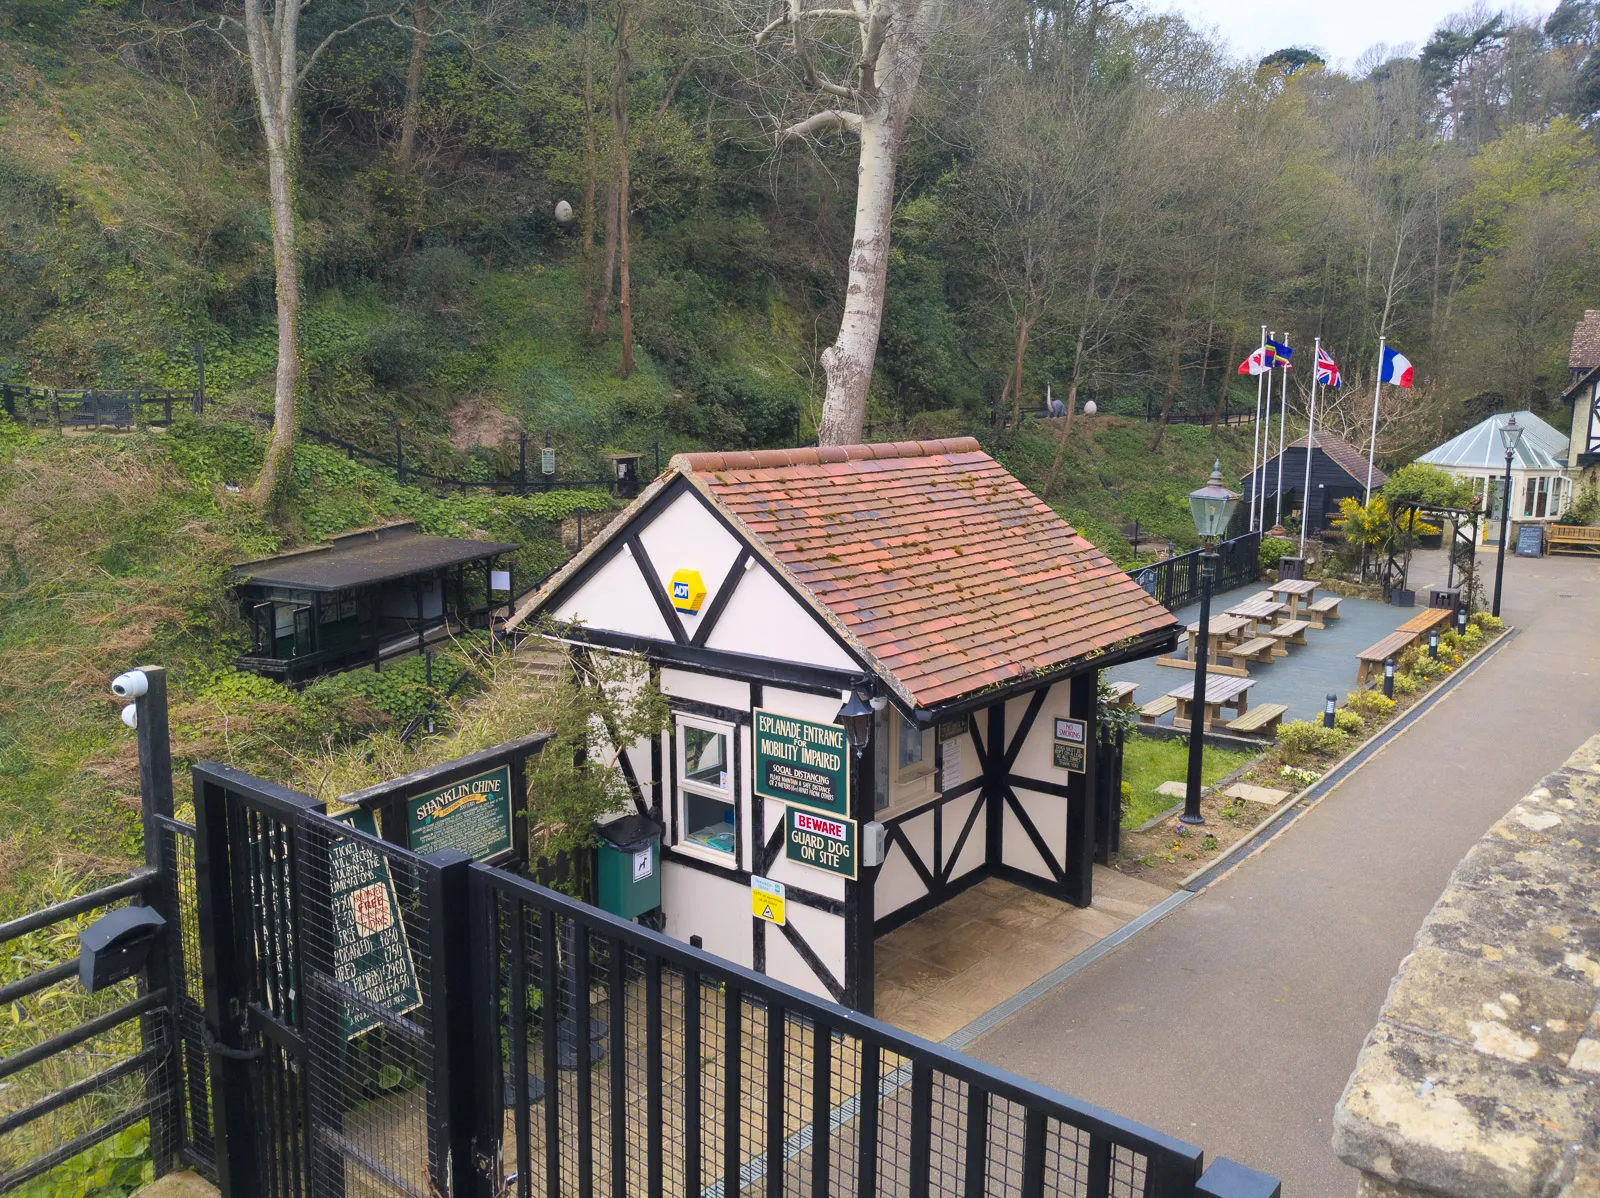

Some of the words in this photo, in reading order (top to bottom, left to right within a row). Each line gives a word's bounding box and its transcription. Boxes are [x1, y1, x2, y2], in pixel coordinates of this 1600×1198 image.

[674, 585, 688, 597] ADT
[759, 715, 802, 739] ESPLANADE
[803, 725, 843, 749] ENTRANCE
[1059, 729, 1080, 739] SMOKING
[793, 739, 807, 748] FOR
[761, 739, 798, 762] MOBILITY
[801, 748, 841, 772] IMPAIRED
[772, 764, 793, 776] SOCIAL
[794, 769, 830, 785] DISTANCING
[812, 784, 831, 794] DISTANCE
[416, 783, 470, 821] SHANKLIN
[472, 779, 502, 794] CHINE
[798, 814, 842, 837] BEWARE
[333, 842, 358, 858] TICKET
[791, 830, 825, 850] GUARD
[827, 841, 850, 858] DOG
[366, 856, 381, 869] THE
[801, 845, 815, 861] ON
[819, 850, 840, 868] SITE
[358, 897, 383, 912] FREE
[369, 914, 389, 929] DAYS
[338, 926, 356, 946] FREE
